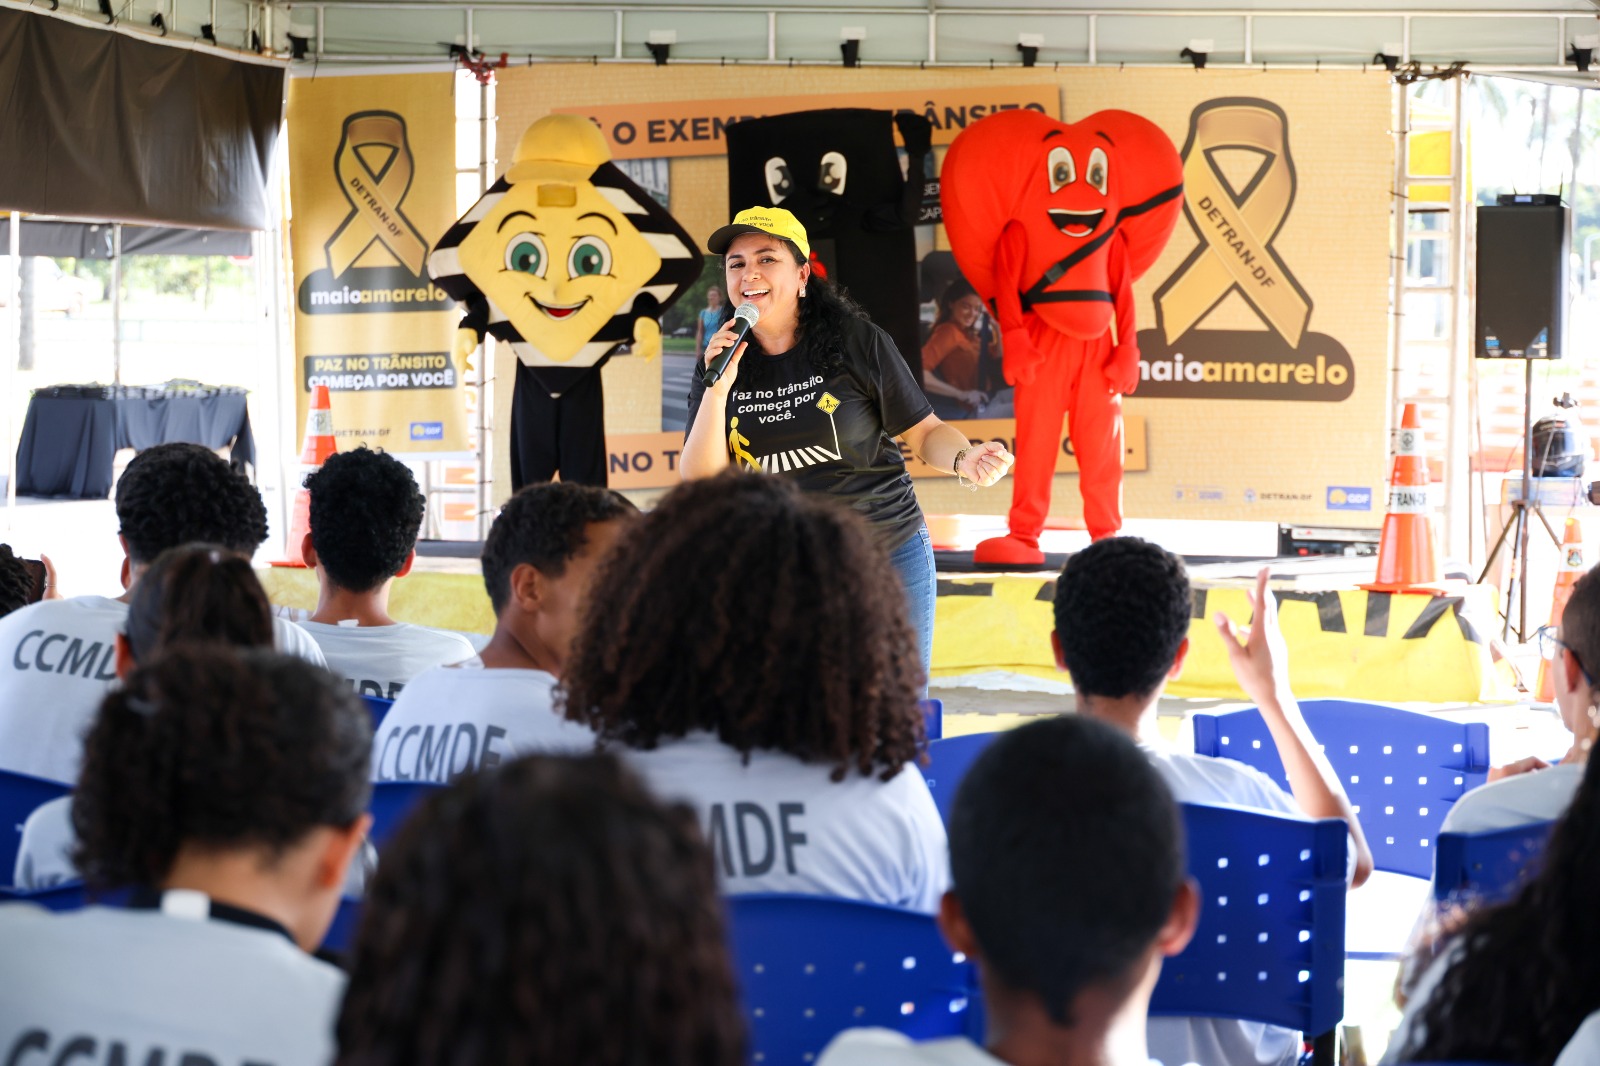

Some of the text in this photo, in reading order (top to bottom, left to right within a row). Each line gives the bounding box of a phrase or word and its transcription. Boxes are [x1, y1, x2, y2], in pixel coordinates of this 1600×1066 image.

[613, 121, 637, 145] O
[647, 114, 757, 144] EXEM
[350, 176, 402, 237] DETRAN-DF
[1197, 196, 1276, 289] DETRAN-DF
[310, 283, 448, 306] maioamarelo
[314, 353, 447, 373] PAZ NO TRÂNSITO
[307, 369, 454, 391] COMEÇA POR VOCÊ
[755, 390, 774, 399] no
[777, 375, 824, 397] trânsito
[737, 391, 817, 414] começa por
[758, 409, 796, 424] você.
[609, 451, 653, 474] NO
